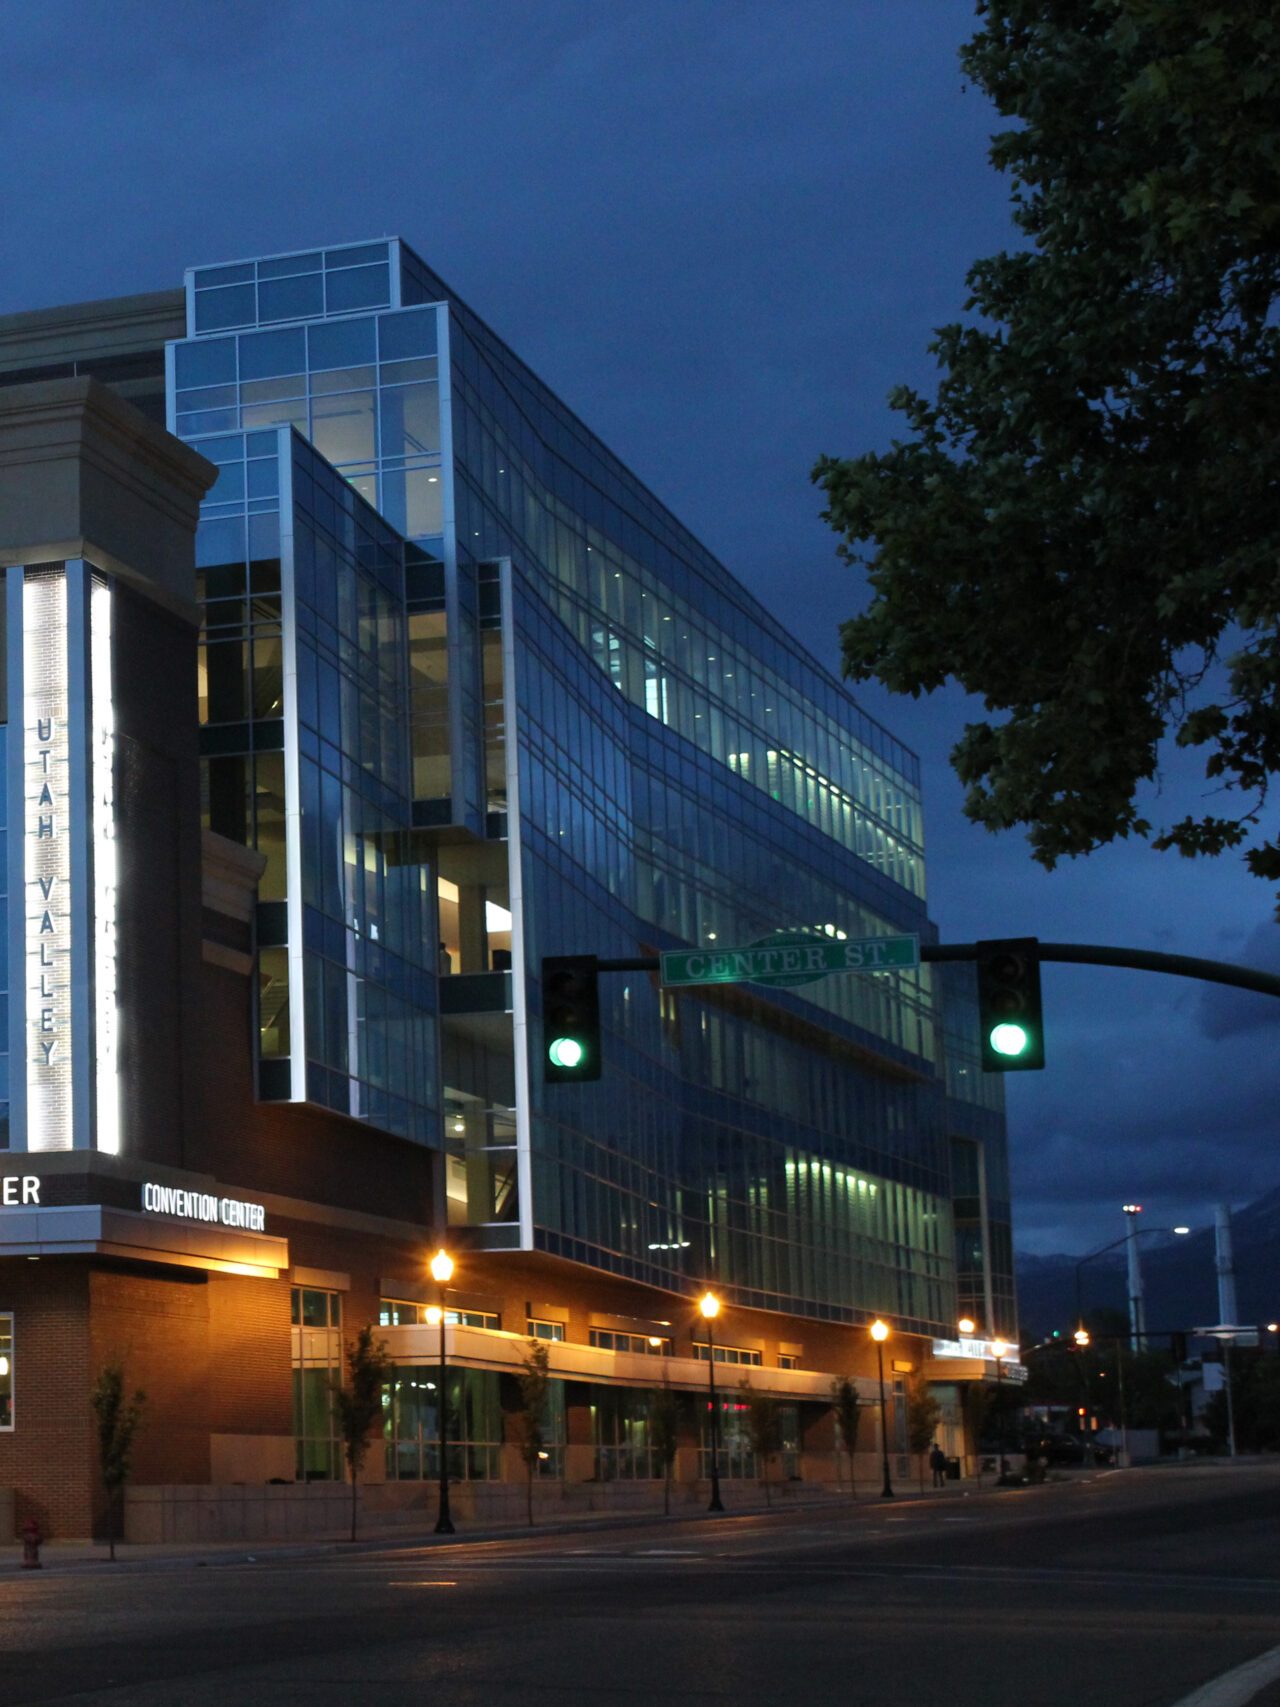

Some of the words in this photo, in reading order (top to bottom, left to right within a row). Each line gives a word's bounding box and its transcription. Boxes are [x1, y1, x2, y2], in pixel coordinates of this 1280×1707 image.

[37, 718, 54, 839] UTAH
[38, 876, 56, 1066] VALLEY
[685, 946, 828, 979] CENTER
[843, 942, 895, 968] ST.
[143, 1182, 218, 1222] CONVENTION
[220, 1198, 265, 1231] CENTER
